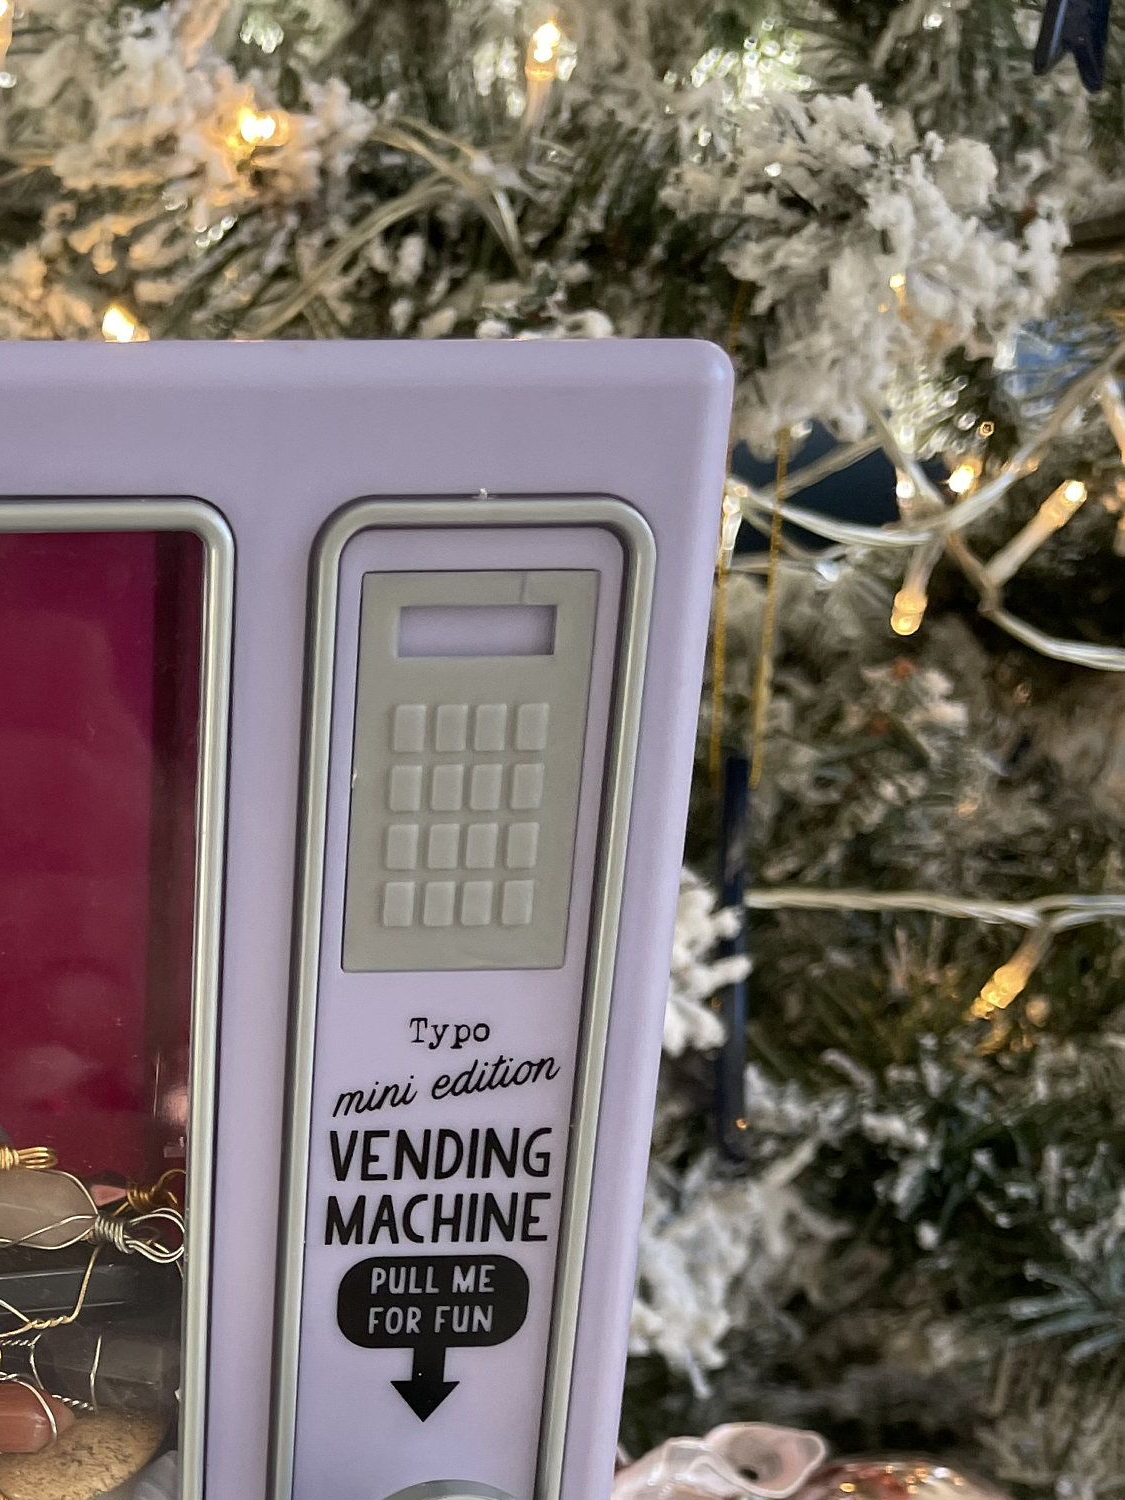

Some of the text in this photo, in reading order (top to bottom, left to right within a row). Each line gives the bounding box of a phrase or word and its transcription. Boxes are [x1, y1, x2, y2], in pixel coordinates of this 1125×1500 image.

[409, 1017, 491, 1049] Typo
[332, 1055, 562, 1118] mini edition
[328, 1127, 553, 1182] VENDING
[324, 1192, 552, 1246] MACHINE
[370, 1265, 496, 1295] PULL ME
[368, 1305, 494, 1335] FOR FUN
